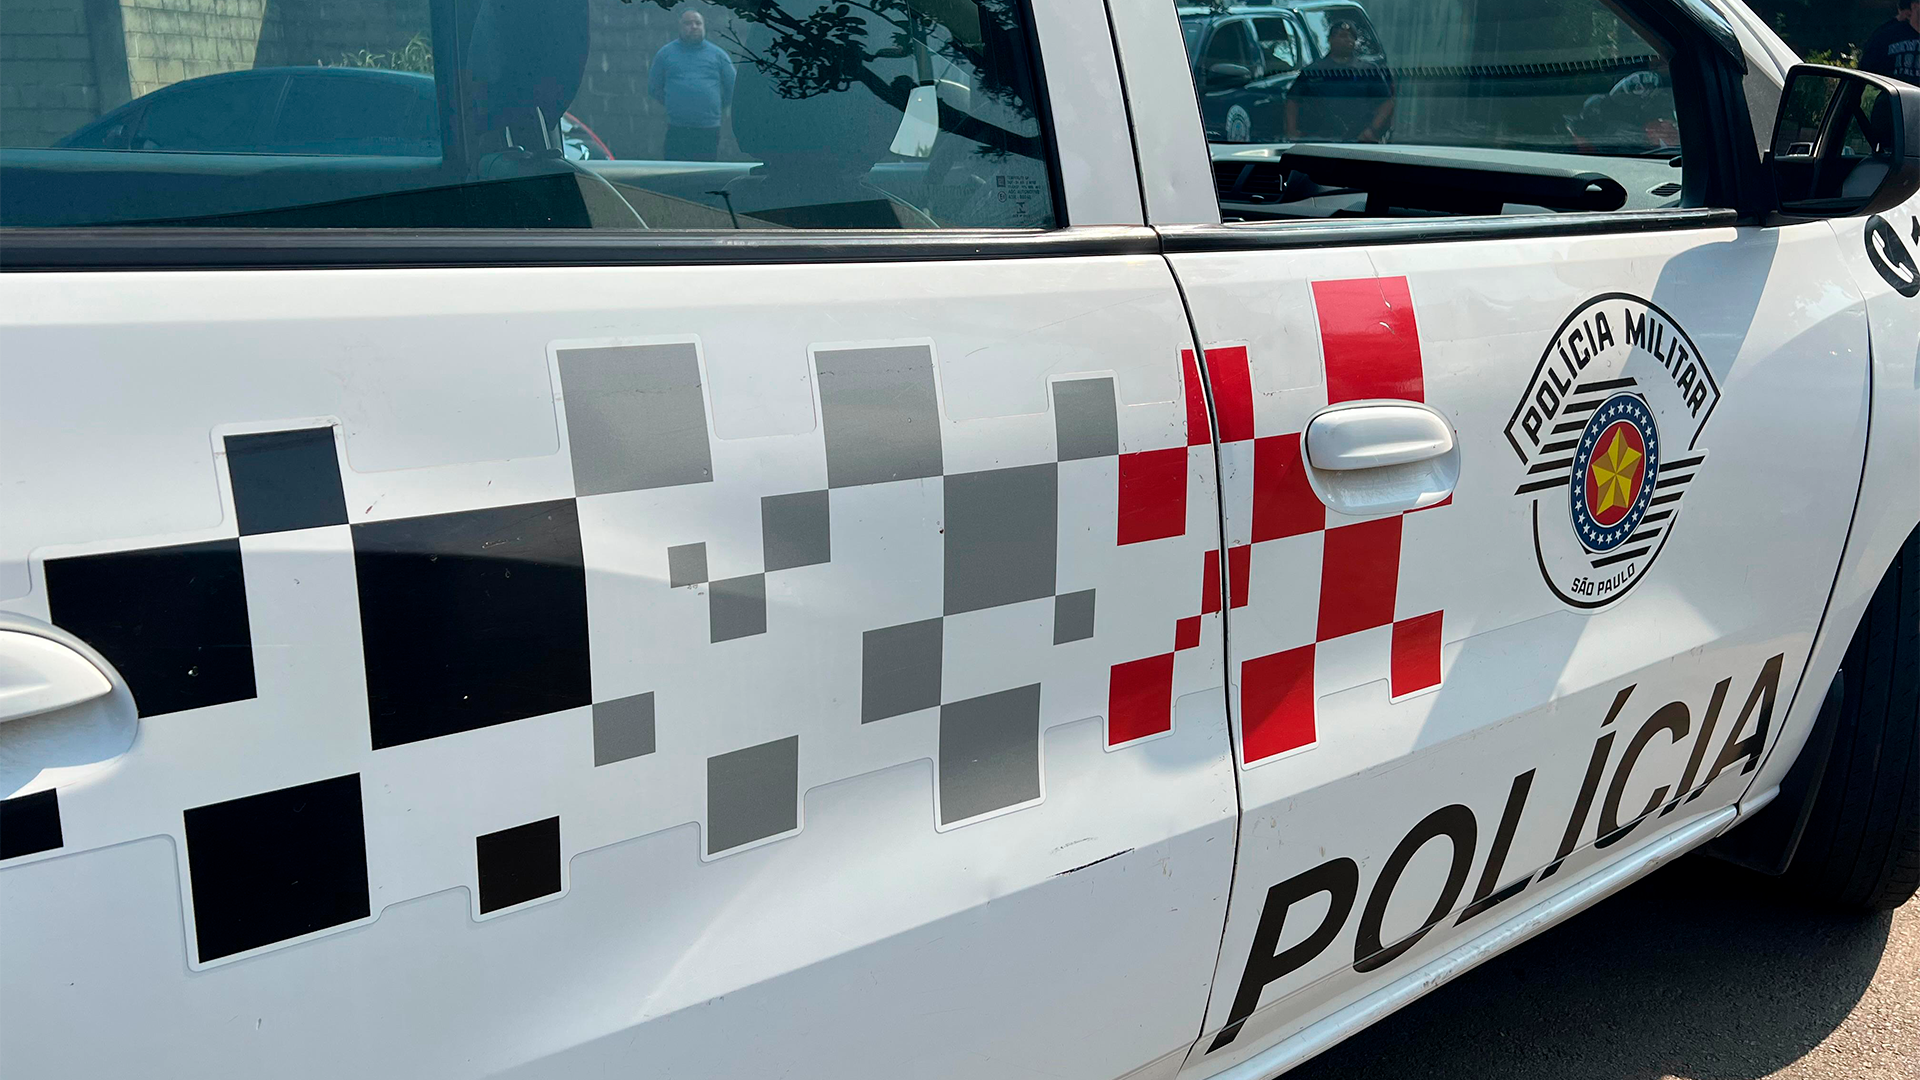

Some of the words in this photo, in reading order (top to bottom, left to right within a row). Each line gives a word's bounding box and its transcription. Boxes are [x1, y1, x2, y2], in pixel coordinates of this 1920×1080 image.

[1522, 311, 1614, 446] POLÍCIA
[1625, 308, 1707, 418] MILITAR
[1571, 577, 1595, 597] SÃO
[1597, 562, 1635, 596] PAULO
[1205, 652, 1784, 1055] POLÍCIA
